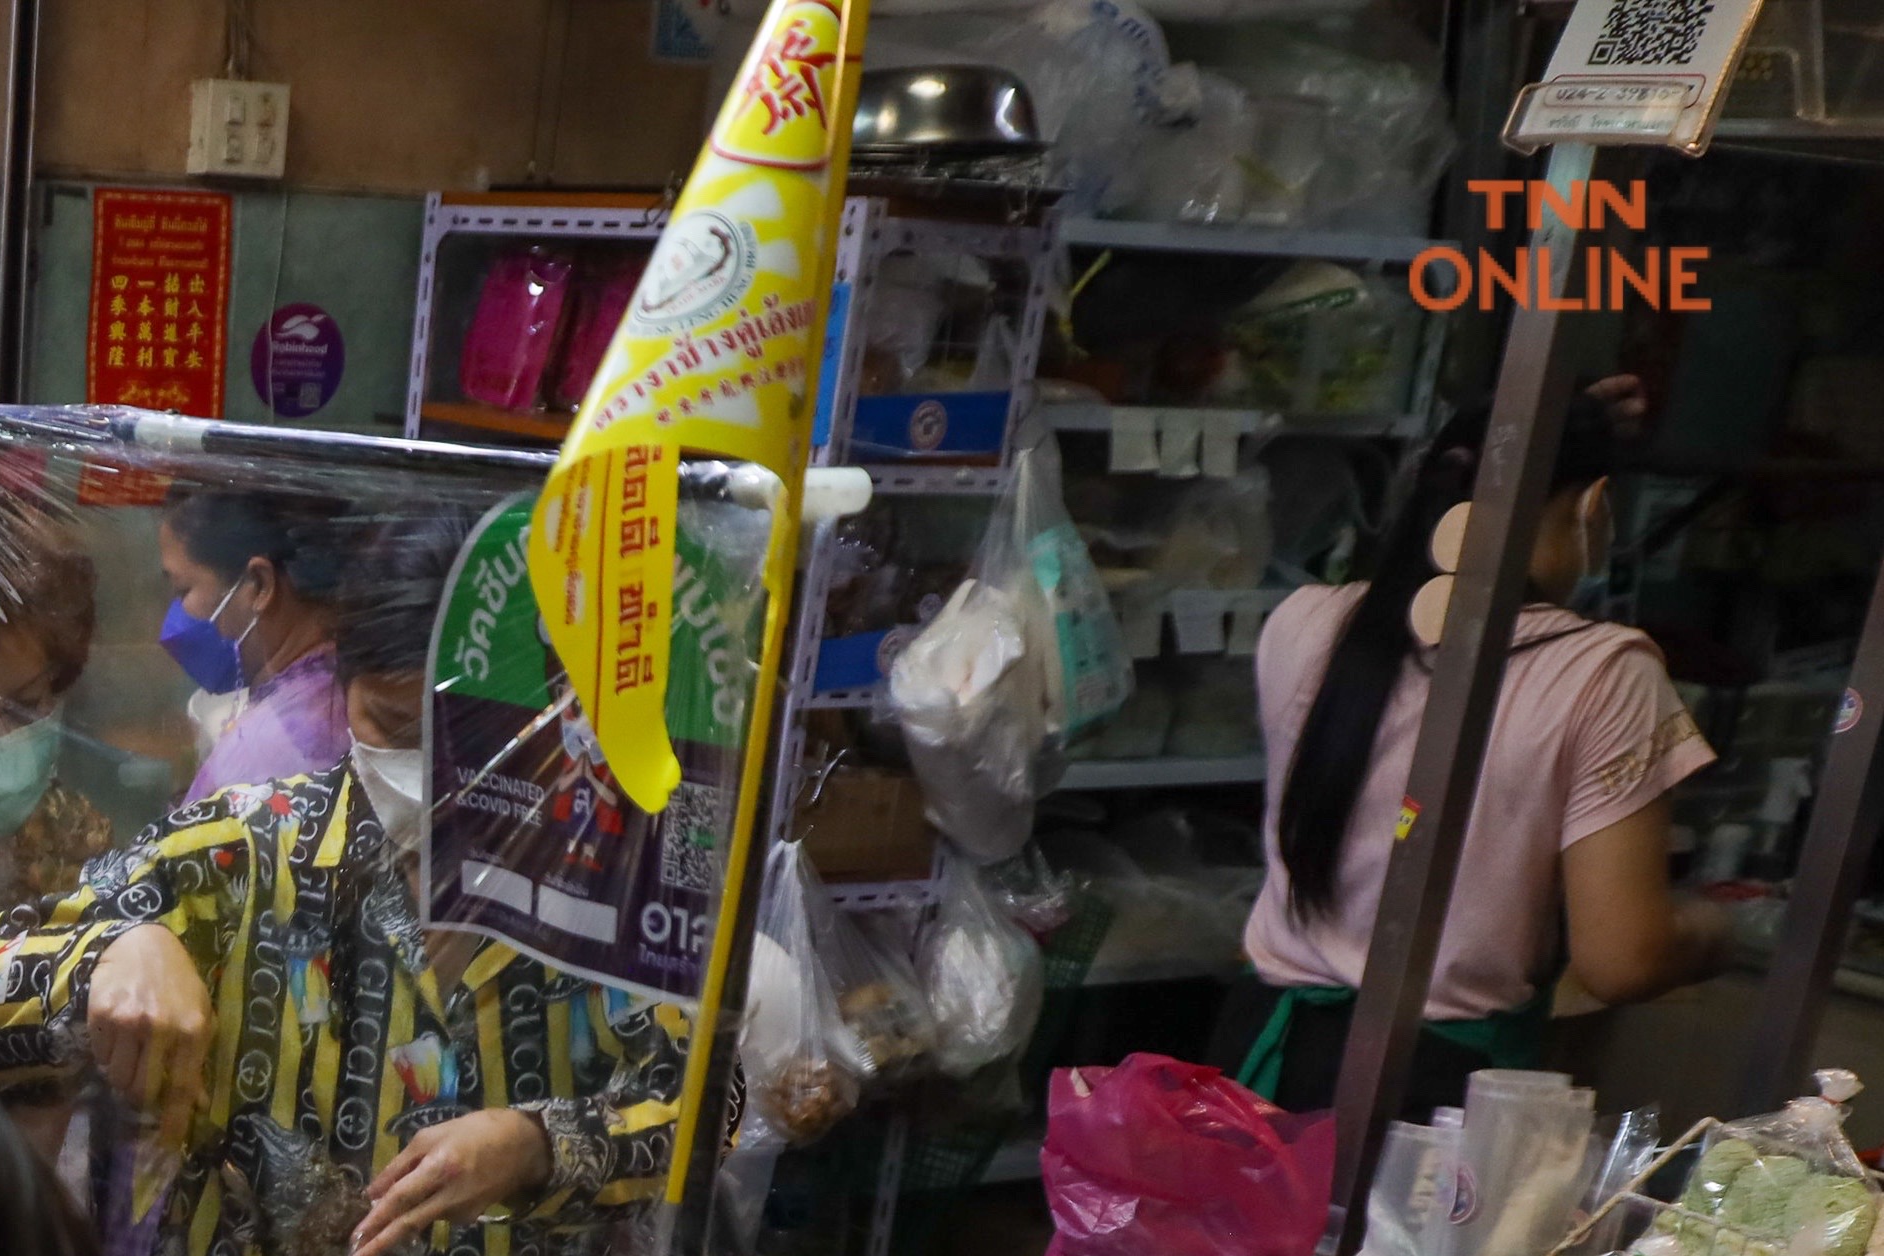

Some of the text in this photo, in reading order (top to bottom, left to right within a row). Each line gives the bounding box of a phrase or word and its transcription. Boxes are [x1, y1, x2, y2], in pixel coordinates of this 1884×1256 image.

[456, 766, 546, 801] VACCINATED
[345, 958, 389, 1085] GUCCI
[508, 983, 545, 1101] GUCC
